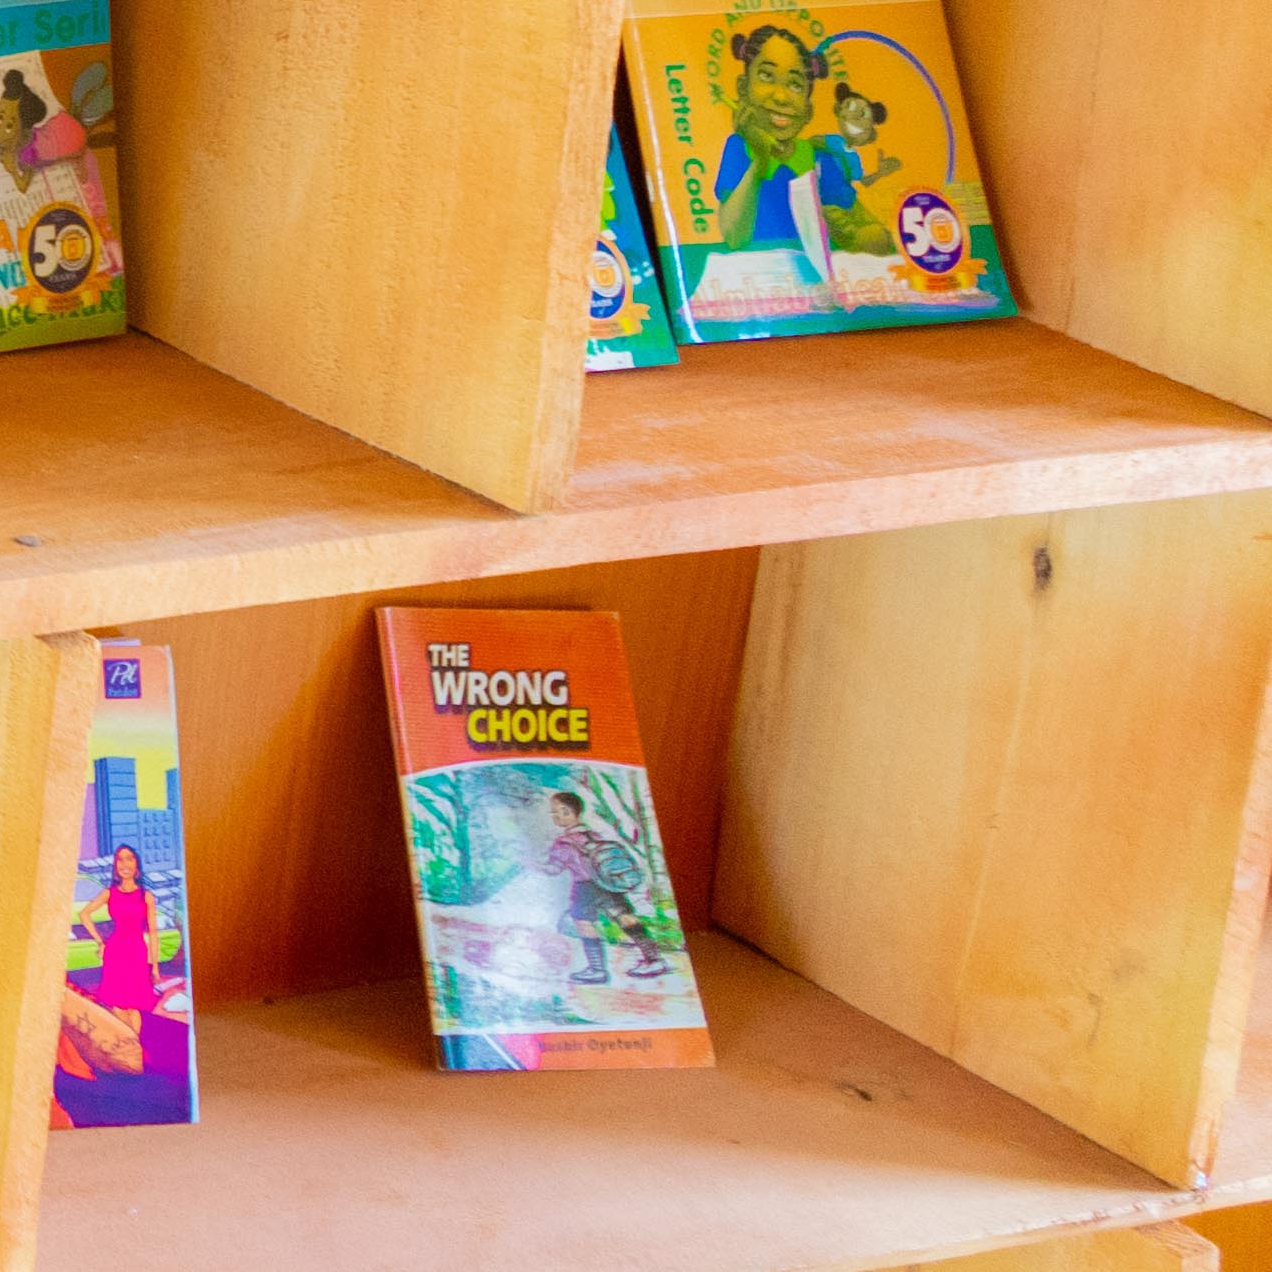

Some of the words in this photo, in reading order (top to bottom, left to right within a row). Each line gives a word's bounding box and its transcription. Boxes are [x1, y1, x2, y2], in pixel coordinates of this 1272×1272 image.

[428, 644, 471, 669] THE
[431, 671, 568, 707] WRONG
[468, 708, 588, 743] CHOICE
